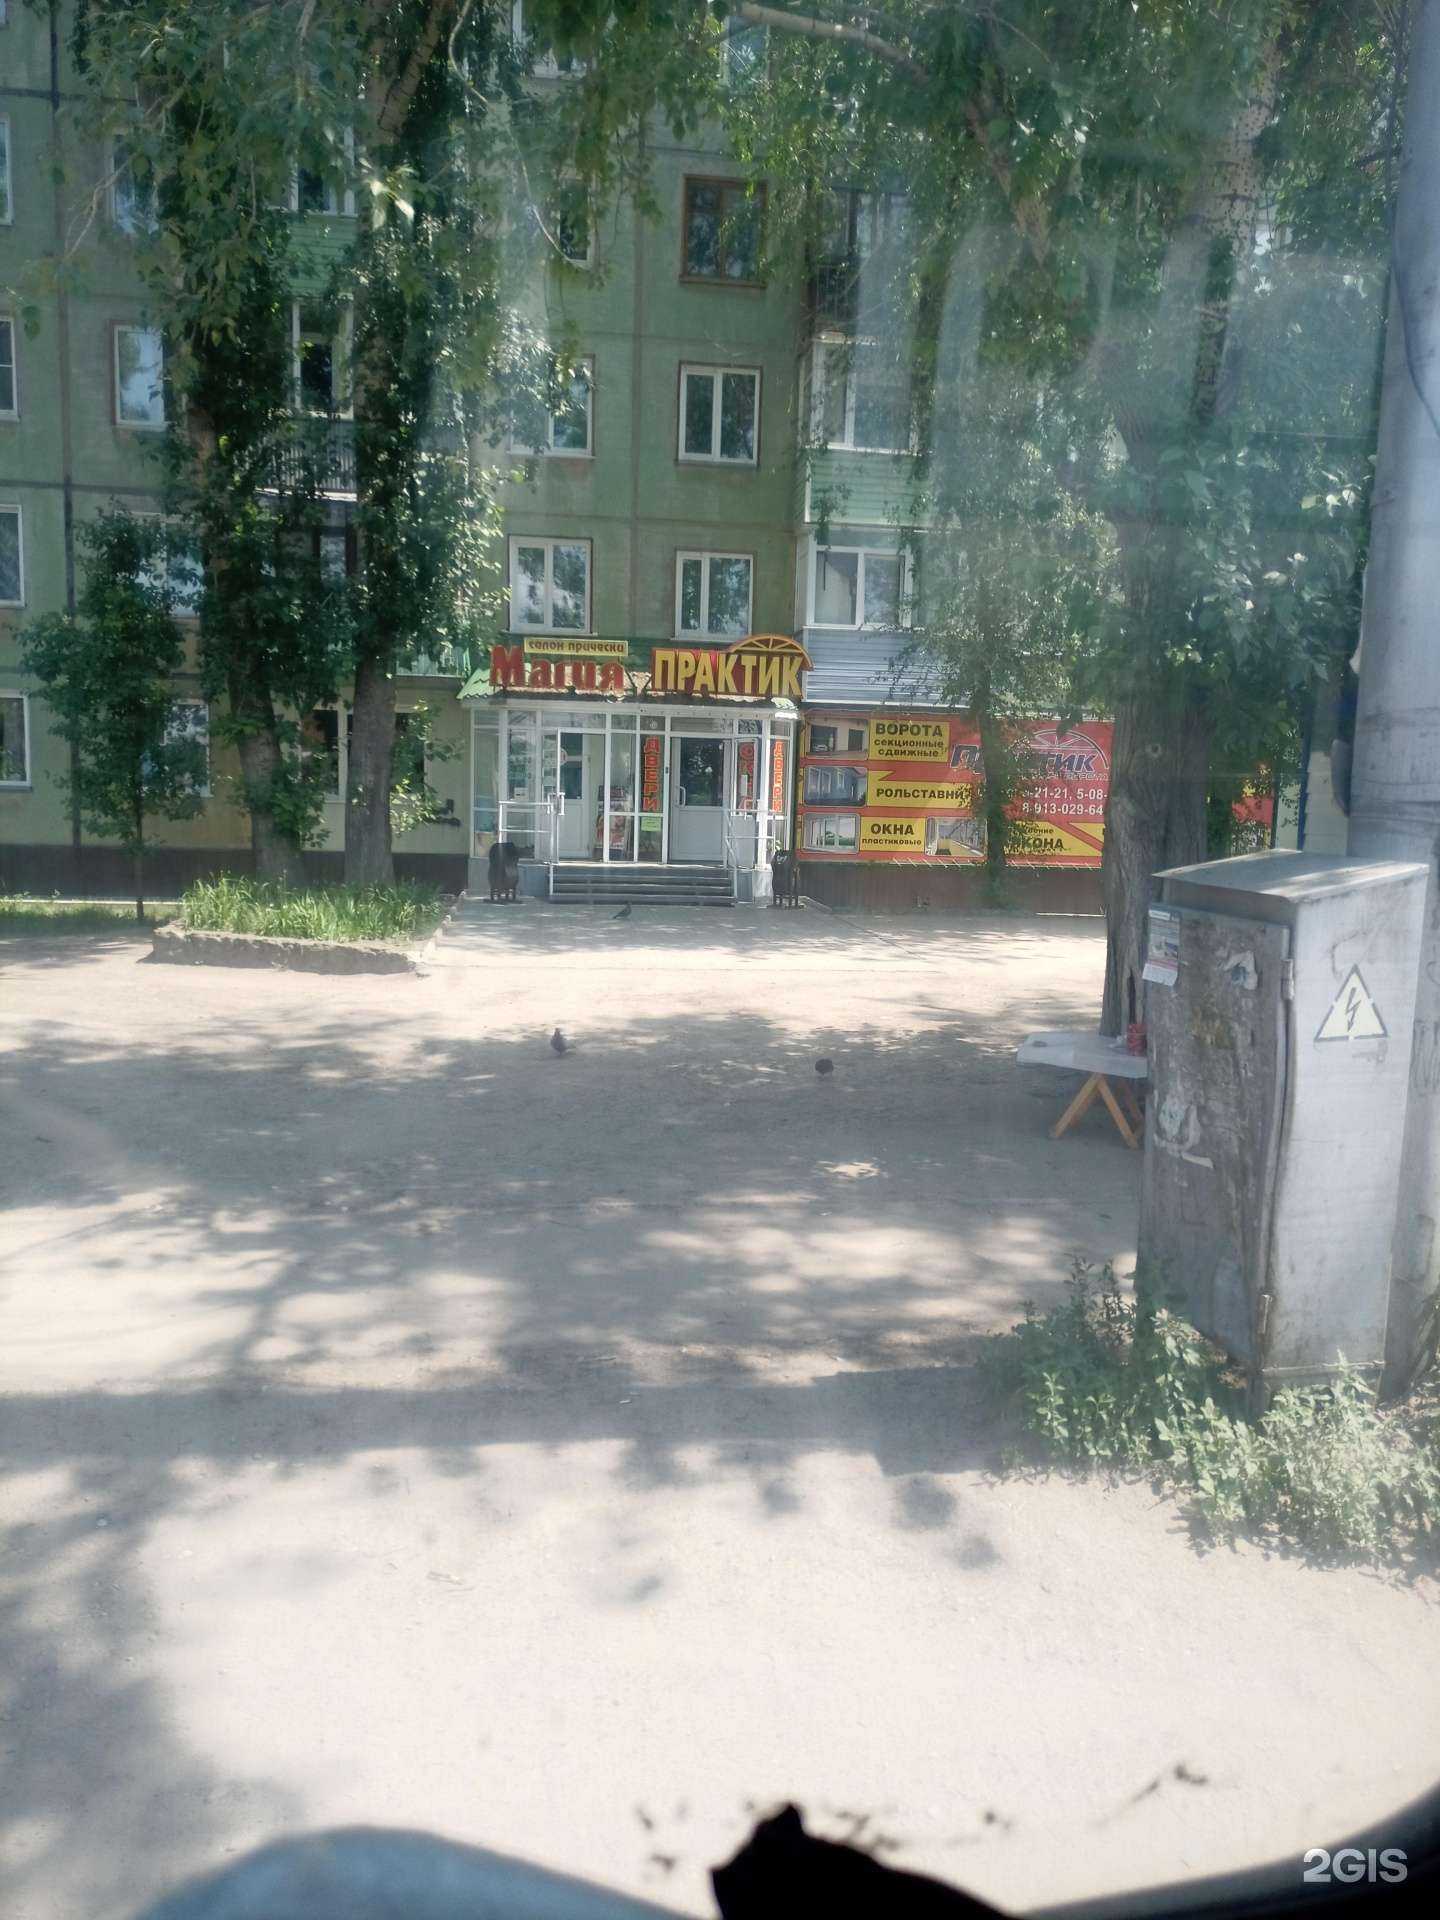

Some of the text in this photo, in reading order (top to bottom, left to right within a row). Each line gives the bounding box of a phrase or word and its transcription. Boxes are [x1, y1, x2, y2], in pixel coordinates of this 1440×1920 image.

[567, 642, 625, 654] прически
[489, 644, 625, 690] Магия
[653, 649, 803, 697] ПРАКТИК
[875, 723, 943, 737] ВОРОТА
[874, 739, 944, 749] секционные
[878, 749, 939, 758] сдвижные
[642, 736, 660, 812] ДВЕРИ
[876, 788, 965, 800] РОЛЬСТАВНИ
[871, 823, 914, 835] ОКНА
[861, 838, 922, 846] пластиковые
